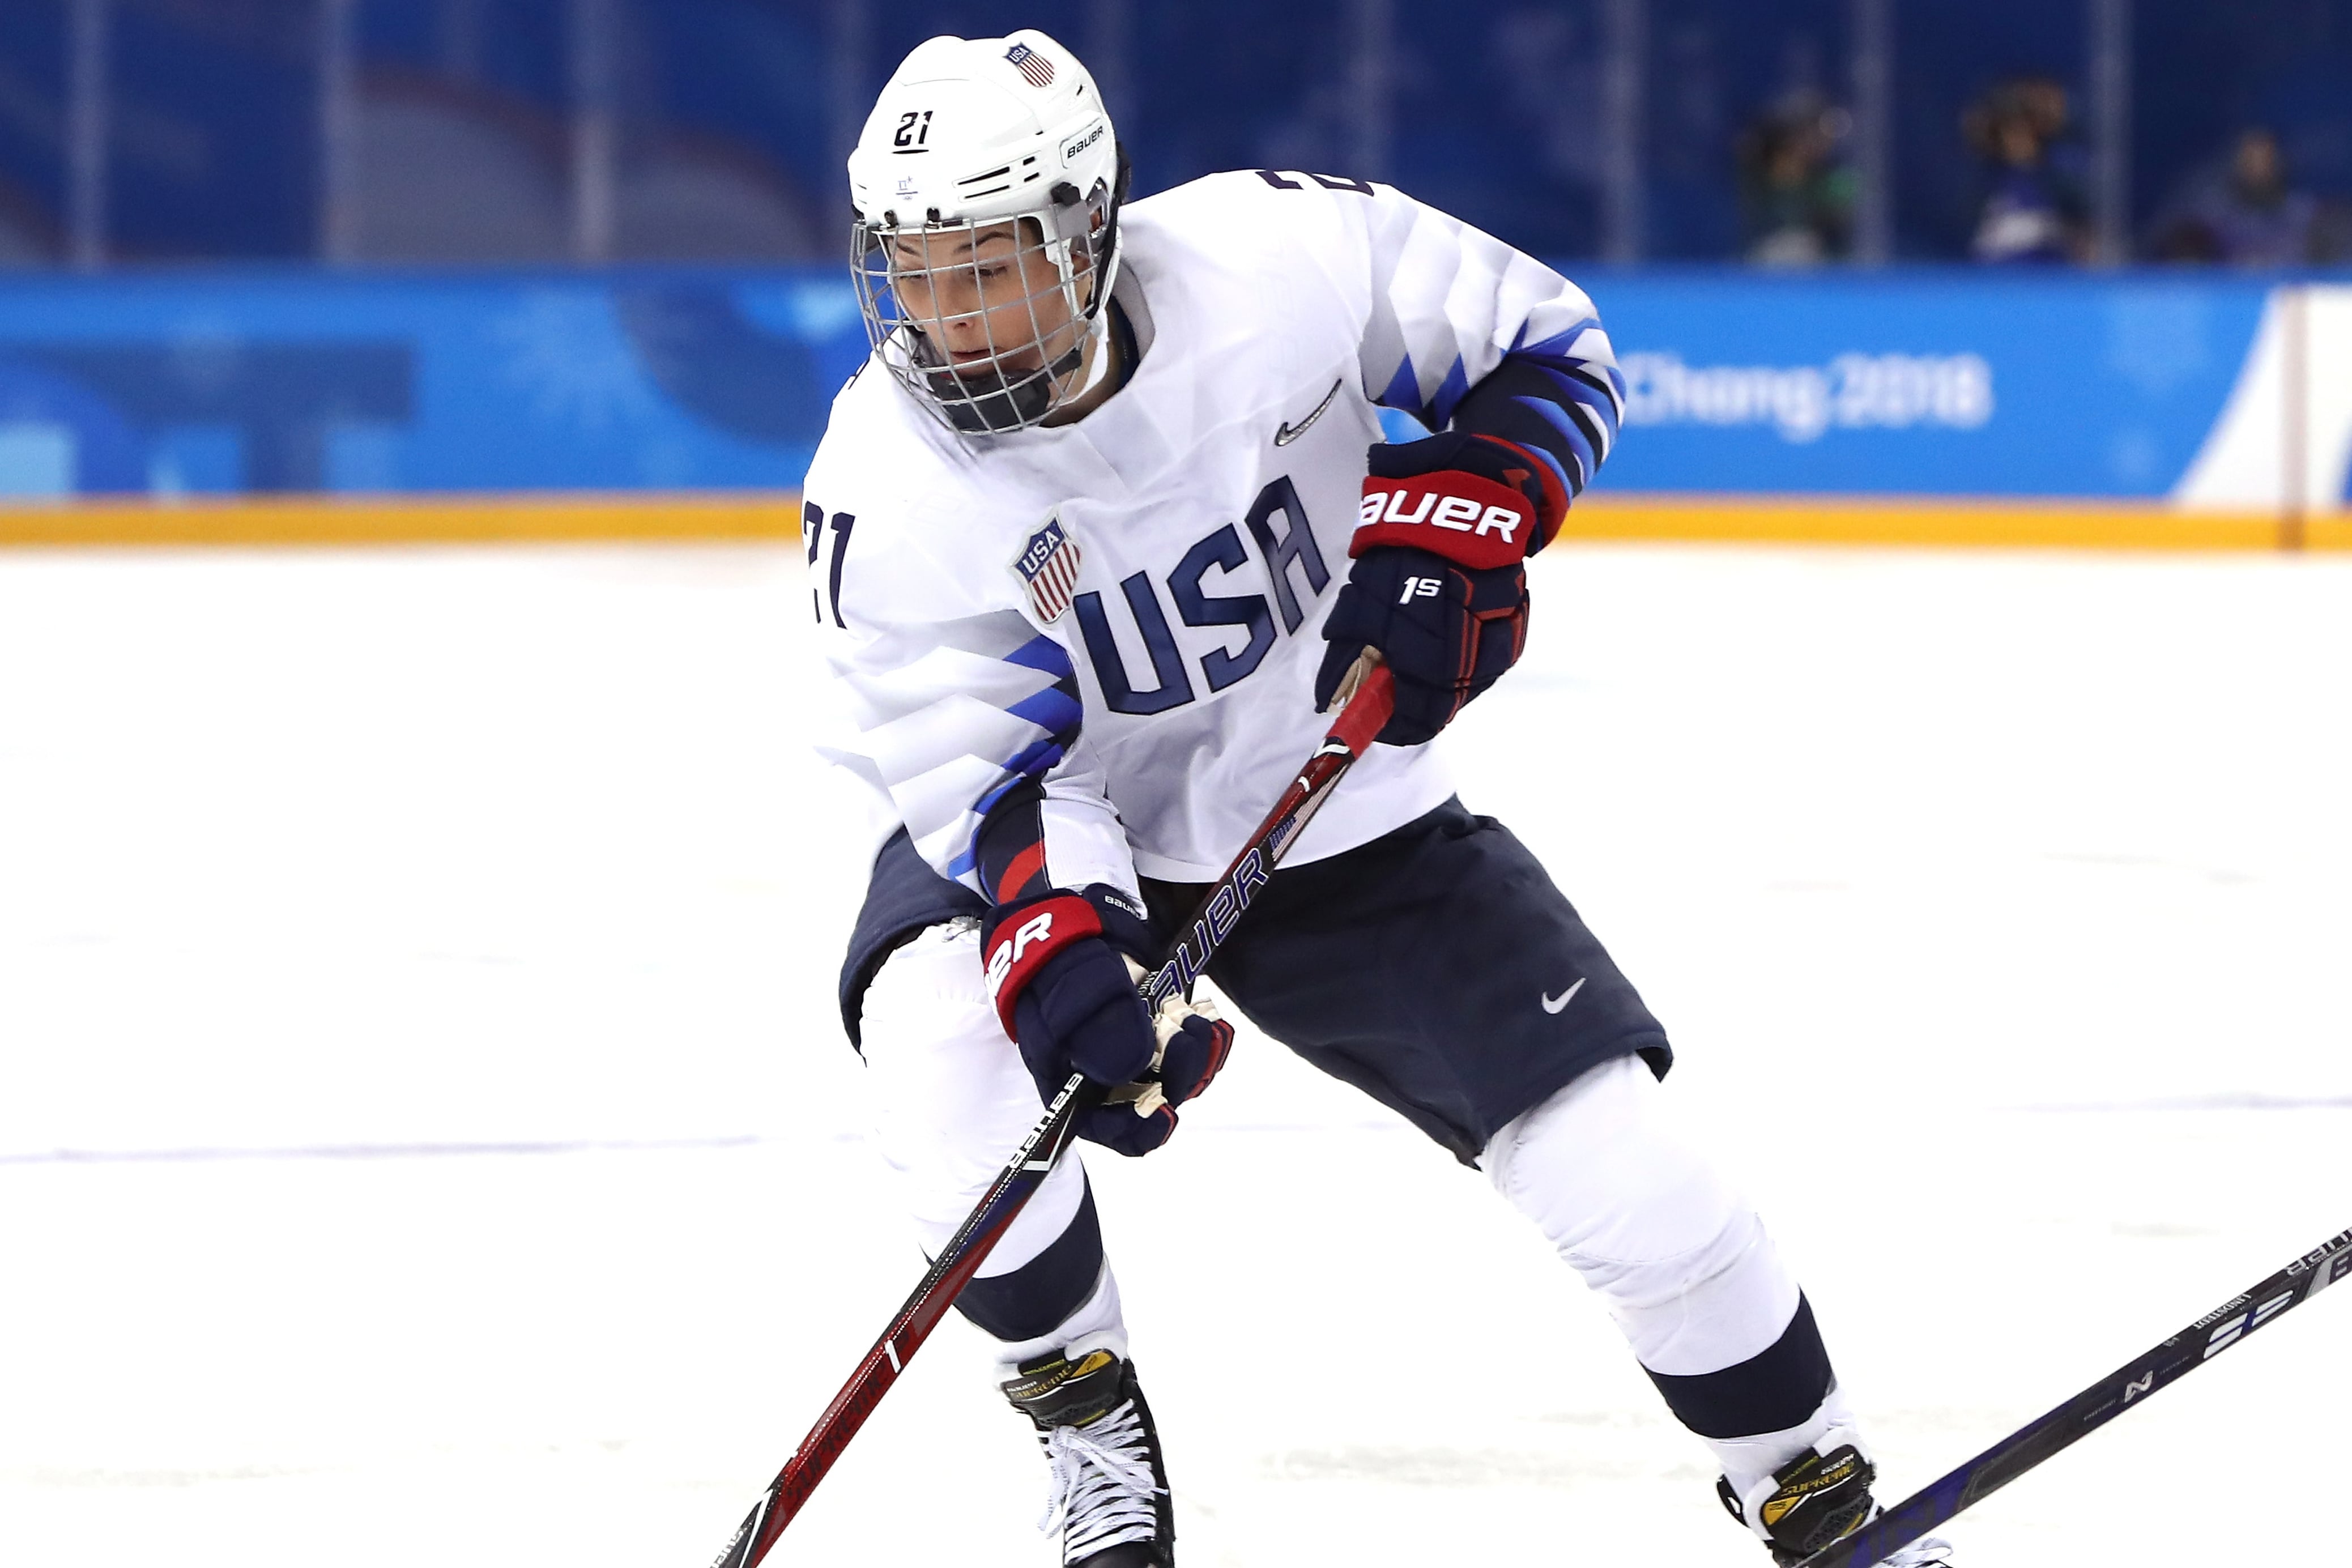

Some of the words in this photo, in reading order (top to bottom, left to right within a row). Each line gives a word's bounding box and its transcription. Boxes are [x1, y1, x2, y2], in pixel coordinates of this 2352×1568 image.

[1008, 46, 1029, 63] USA
[893, 110, 934, 147] 21
[1067, 125, 1104, 159] BAUER
[1355, 489, 1522, 544] AUER
[1021, 529, 1060, 574] USA
[1072, 474, 1331, 717] USA
[1105, 894, 1141, 918] BAU
[1140, 847, 1269, 1020] AUER
[1008, 1072, 1084, 1169] BAUER
